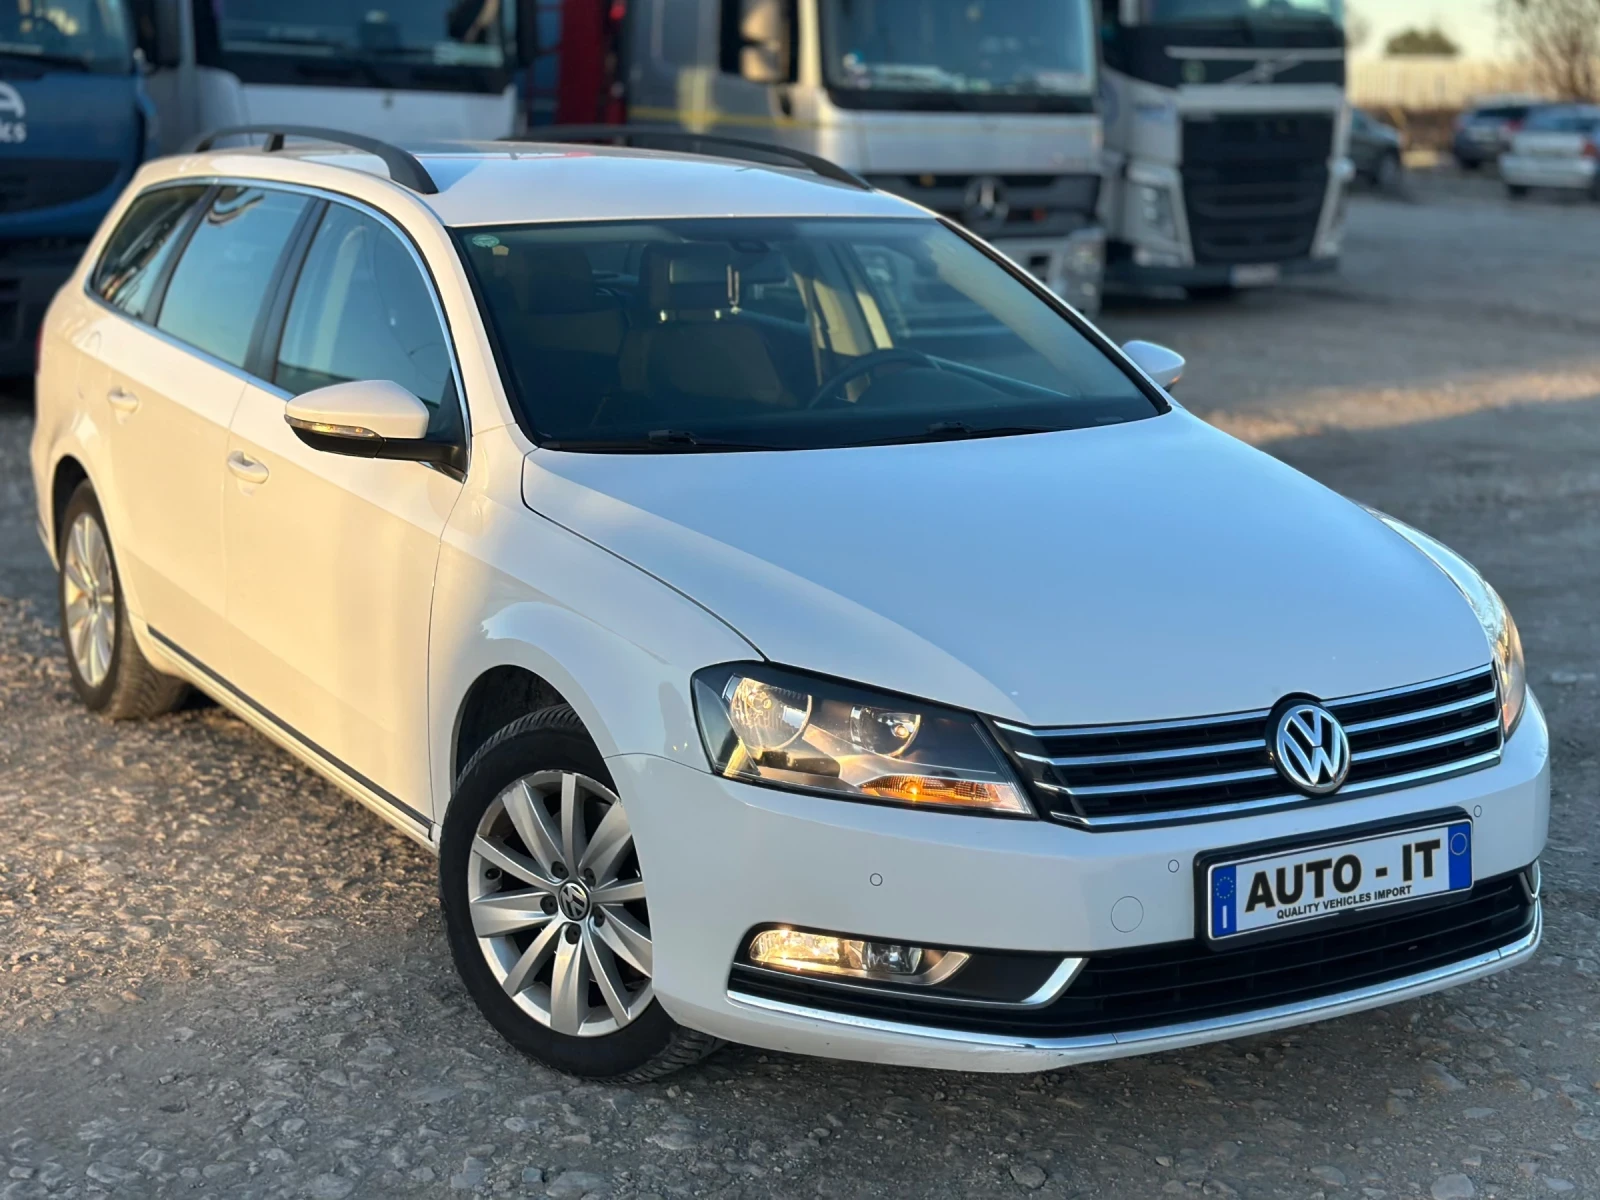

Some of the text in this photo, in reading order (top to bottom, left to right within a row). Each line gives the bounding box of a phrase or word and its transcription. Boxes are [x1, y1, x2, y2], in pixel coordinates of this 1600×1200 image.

[1277, 704, 1349, 794] VW
[561, 882, 588, 920] VW
[1245, 854, 1362, 912] AUTO
[1402, 839, 1441, 882] IT
[1277, 885, 1412, 919] QUALITY VEHICLES IMPORT
